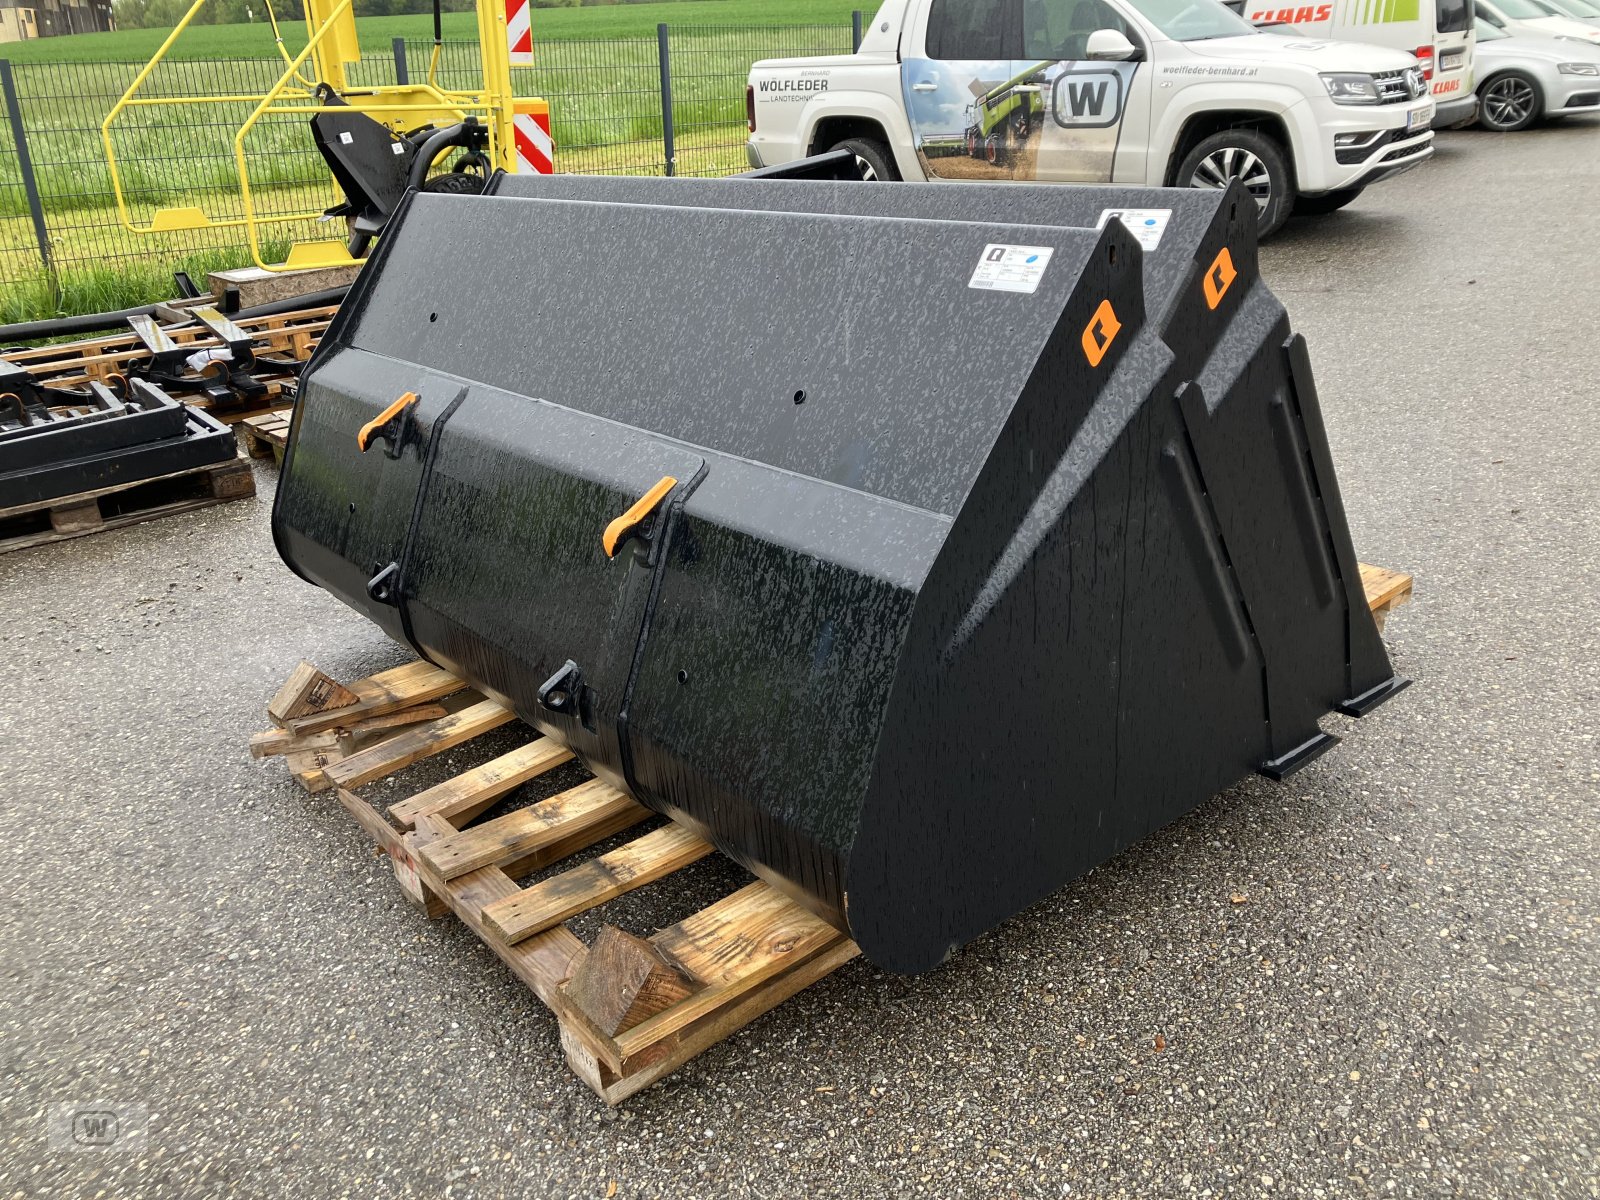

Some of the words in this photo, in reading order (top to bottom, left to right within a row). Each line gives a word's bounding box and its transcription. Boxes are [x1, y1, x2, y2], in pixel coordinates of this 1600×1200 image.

[759, 77, 828, 91] WÖLFLEDER
[1432, 79, 1460, 94] CLAAS
[1068, 81, 1109, 117] W
